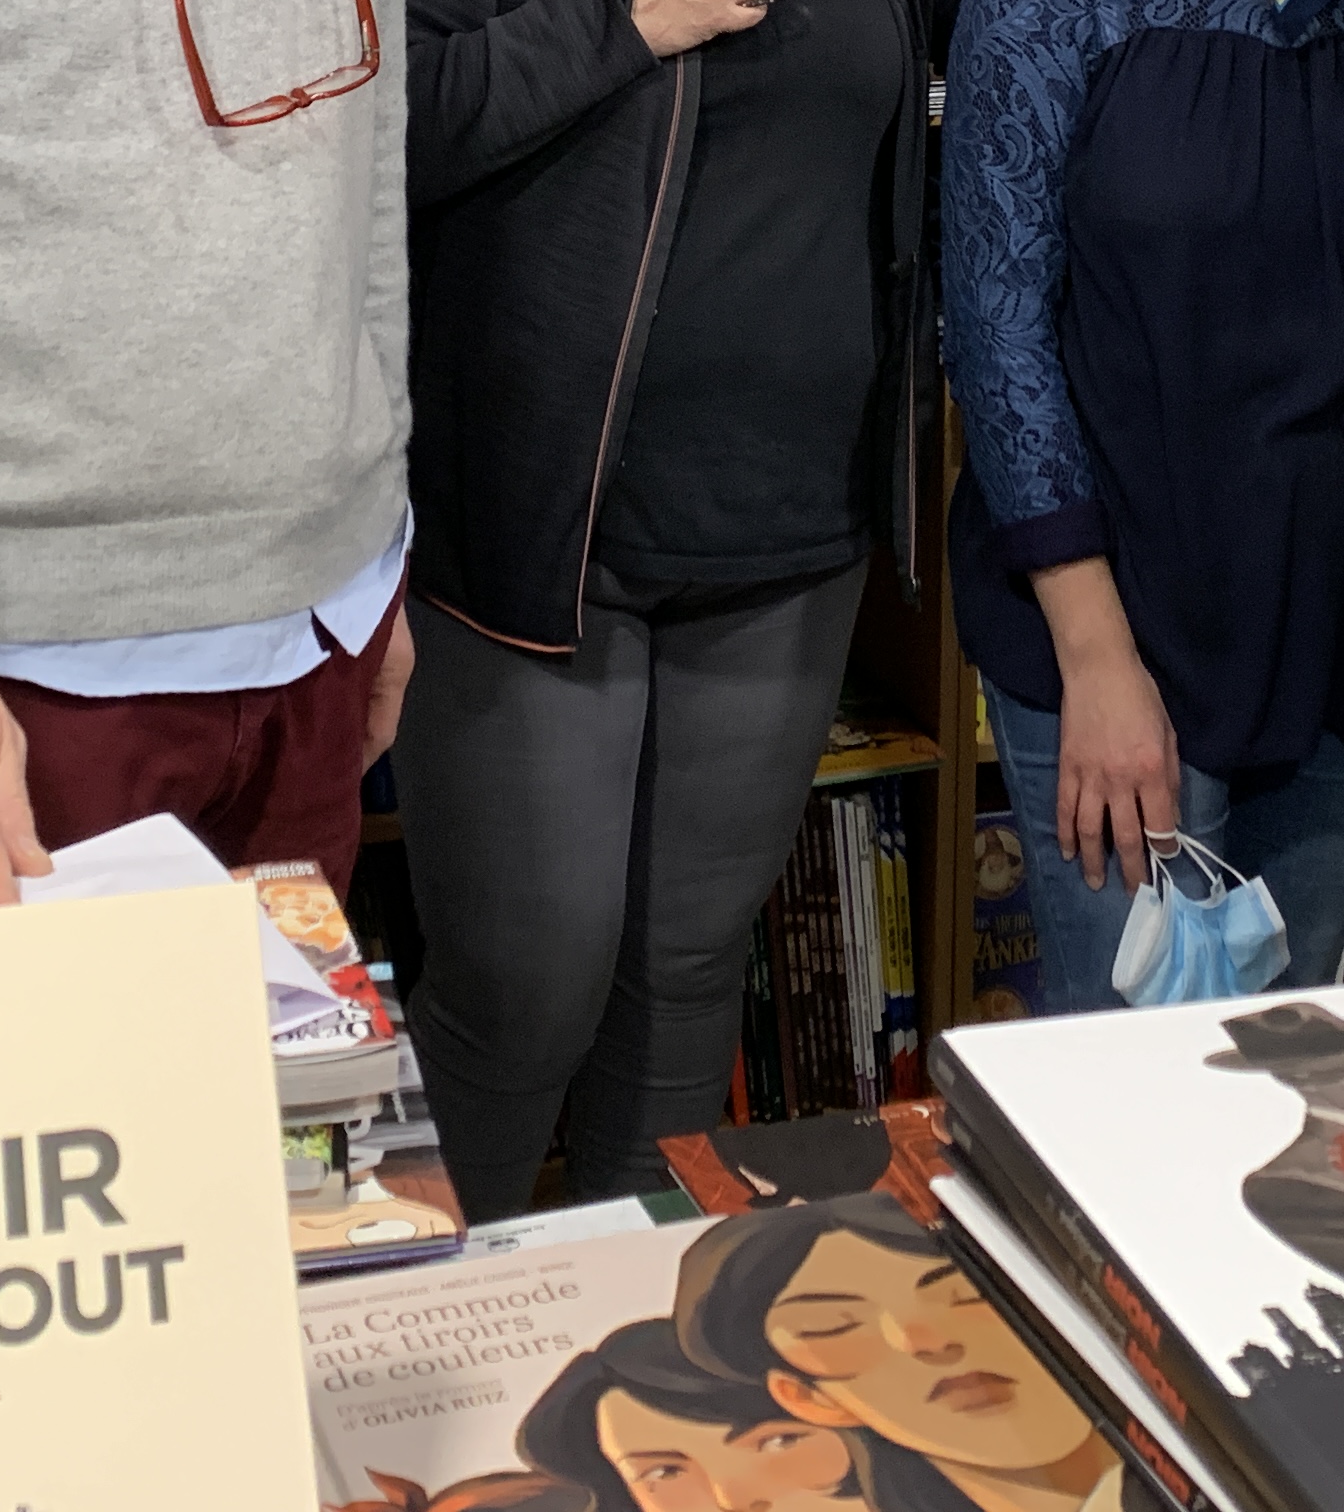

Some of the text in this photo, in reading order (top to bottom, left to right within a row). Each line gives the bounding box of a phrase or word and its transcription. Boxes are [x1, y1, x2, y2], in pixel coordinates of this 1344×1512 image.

[302, 1319, 357, 1346] La
[364, 1281, 582, 1333] Commode
[312, 1314, 535, 1370] aux tiroirs
[323, 1330, 575, 1394] de couleurs
[363, 1398, 448, 1428] OLIVIA
[450, 1390, 510, 1411] RUIZ
